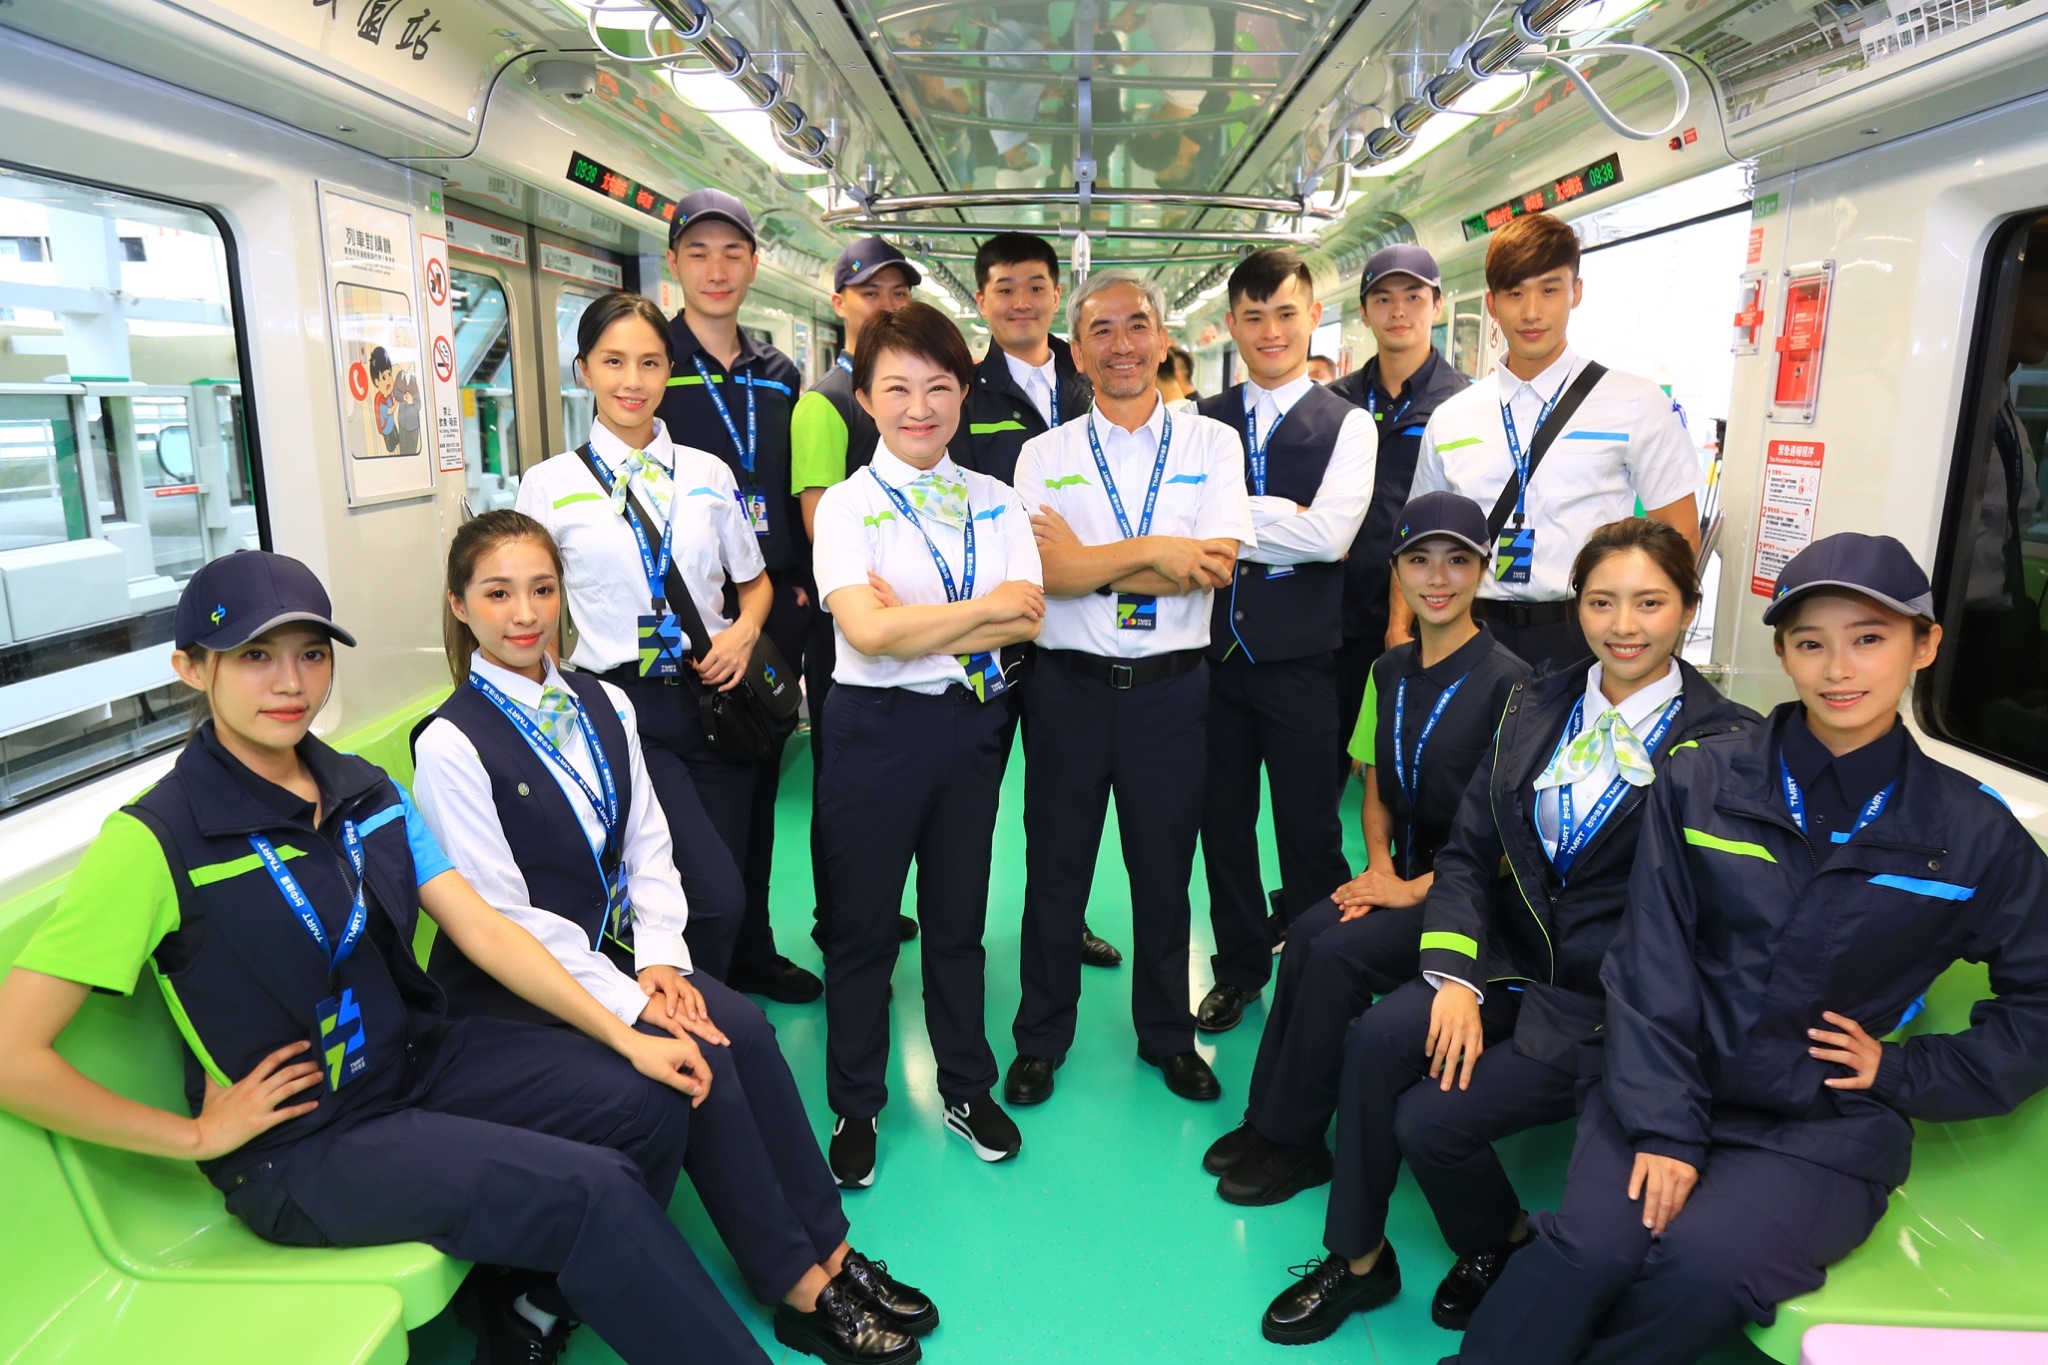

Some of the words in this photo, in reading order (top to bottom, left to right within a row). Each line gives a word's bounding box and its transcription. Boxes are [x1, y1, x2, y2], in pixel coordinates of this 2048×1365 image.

[313, 0, 441, 60] 園站
[1588, 162, 1614, 187] 09:38
[1754, 200, 1765, 217] 03
[345, 227, 391, 254] 列車對講機
[712, 393, 724, 411] TMRT
[734, 437, 744, 455] TMRT
[1508, 428, 1517, 447] TMRT
[1153, 467, 1162, 487] TMRT
[1163, 424, 1171, 441] TMRT
[596, 460, 609, 480] TMRT
[1103, 470, 1113, 490] TMRT
[890, 489, 906, 508] TMRT
[1762, 506, 1767, 518] 2
[1120, 518, 1132, 538] TMRT
[645, 555, 654, 578] TMRT
[659, 553, 669, 576] TMRT
[948, 585, 957, 600] MRT
[772, 682, 785, 697] TMRT
[507, 707, 529, 729] TMRT
[1422, 717, 1435, 738] TMRT
[1646, 724, 1665, 747] TMRT
[592, 739, 605, 764] TMRT
[555, 755, 575, 777] TMRT
[1787, 776, 1799, 806] TMRT
[597, 805, 611, 829] TMRT
[1560, 824, 1569, 852] TMRT
[1567, 830, 1585, 855] TMRT
[258, 842, 282, 871] TMRT
[351, 849, 363, 875] TMRT
[302, 912, 323, 943] TMRT
[344, 911, 363, 944] TMRT
